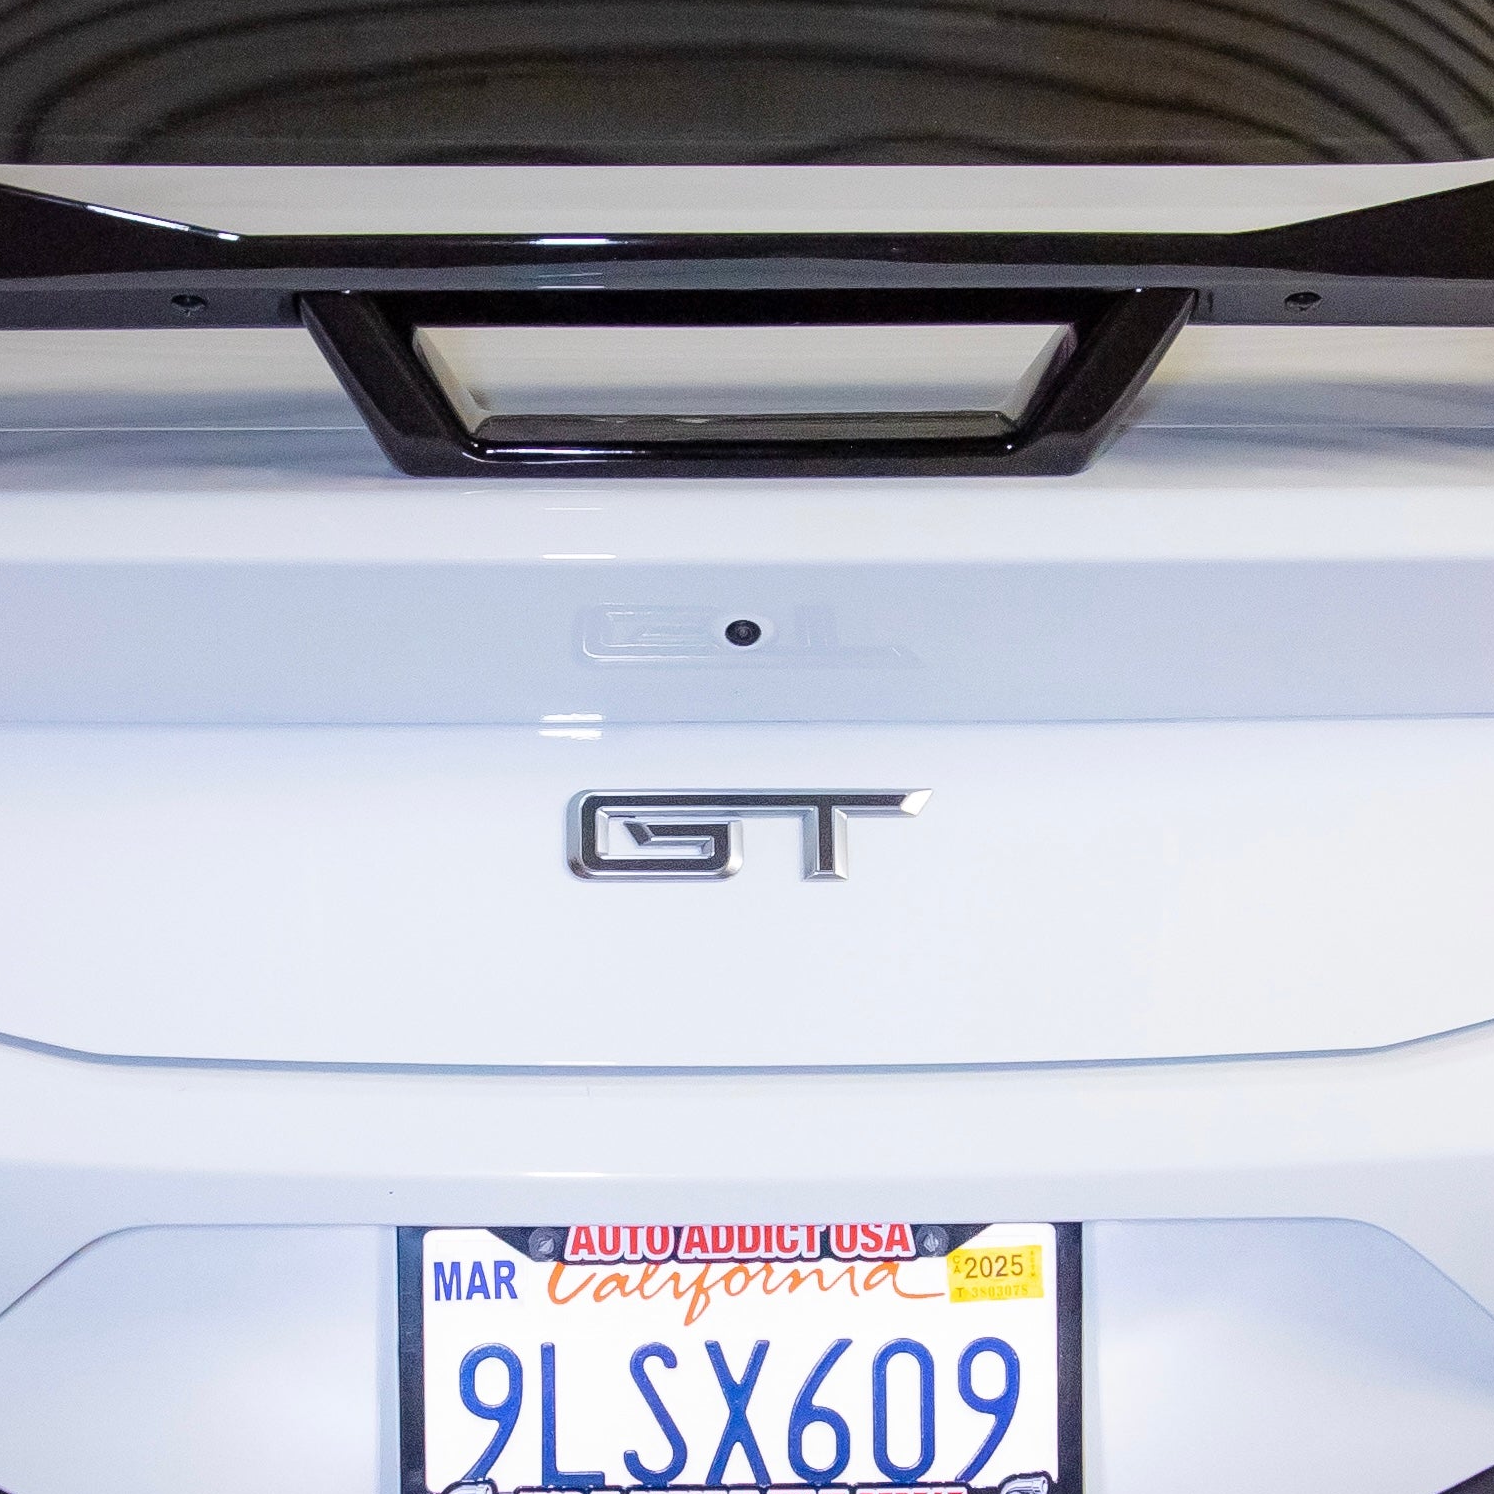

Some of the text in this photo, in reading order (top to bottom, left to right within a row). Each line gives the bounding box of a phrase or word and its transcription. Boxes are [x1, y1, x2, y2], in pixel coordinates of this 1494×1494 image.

[566, 788, 934, 882] GT
[570, 1224, 911, 1256] AUTO ADDICT USA
[964, 1253, 1024, 1279] 2025
[433, 1260, 519, 1302] MAR
[547, 1259, 947, 1326] California
[458, 1336, 1022, 1486] 9LSX609
